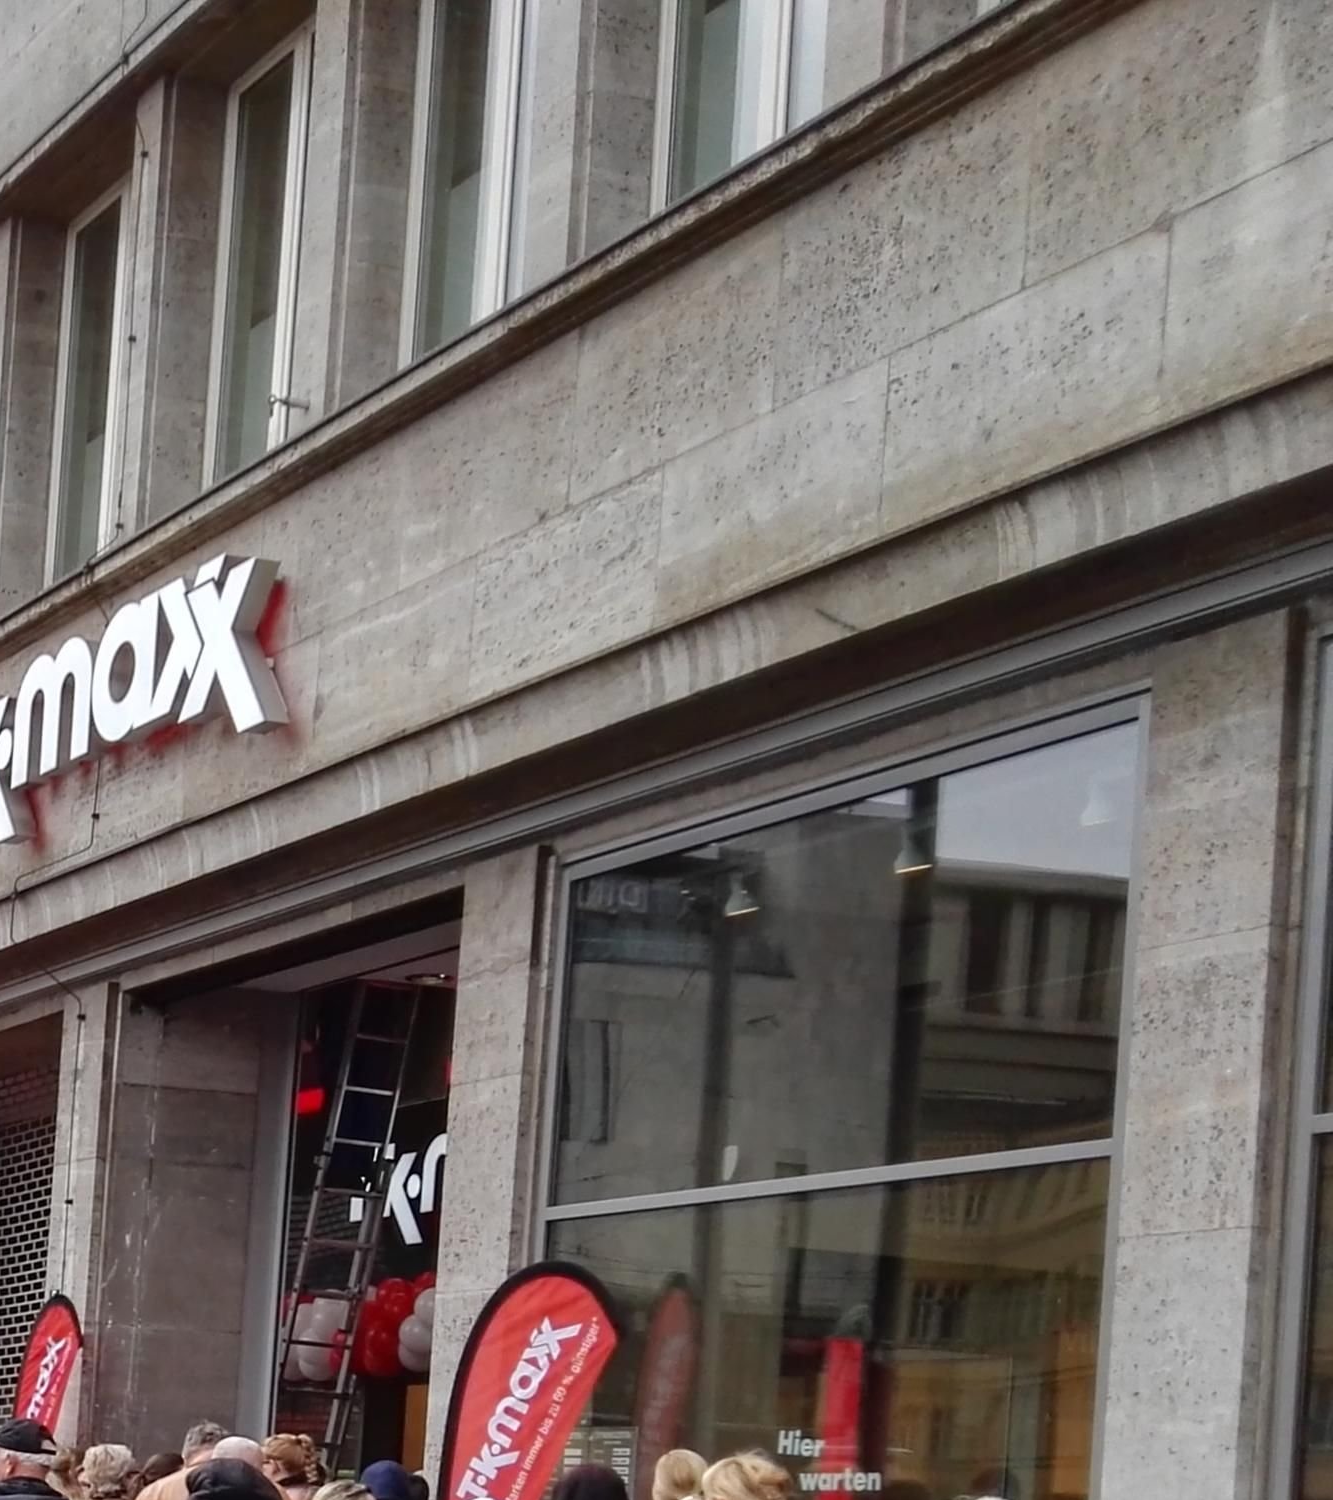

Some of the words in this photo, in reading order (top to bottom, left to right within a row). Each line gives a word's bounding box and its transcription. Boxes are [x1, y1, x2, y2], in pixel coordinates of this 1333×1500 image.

[523, 1434, 545, 1471] immer
[540, 1416, 555, 1438] bis
[777, 1429, 825, 1457] Hier
[799, 1468, 882, 1492] warten
